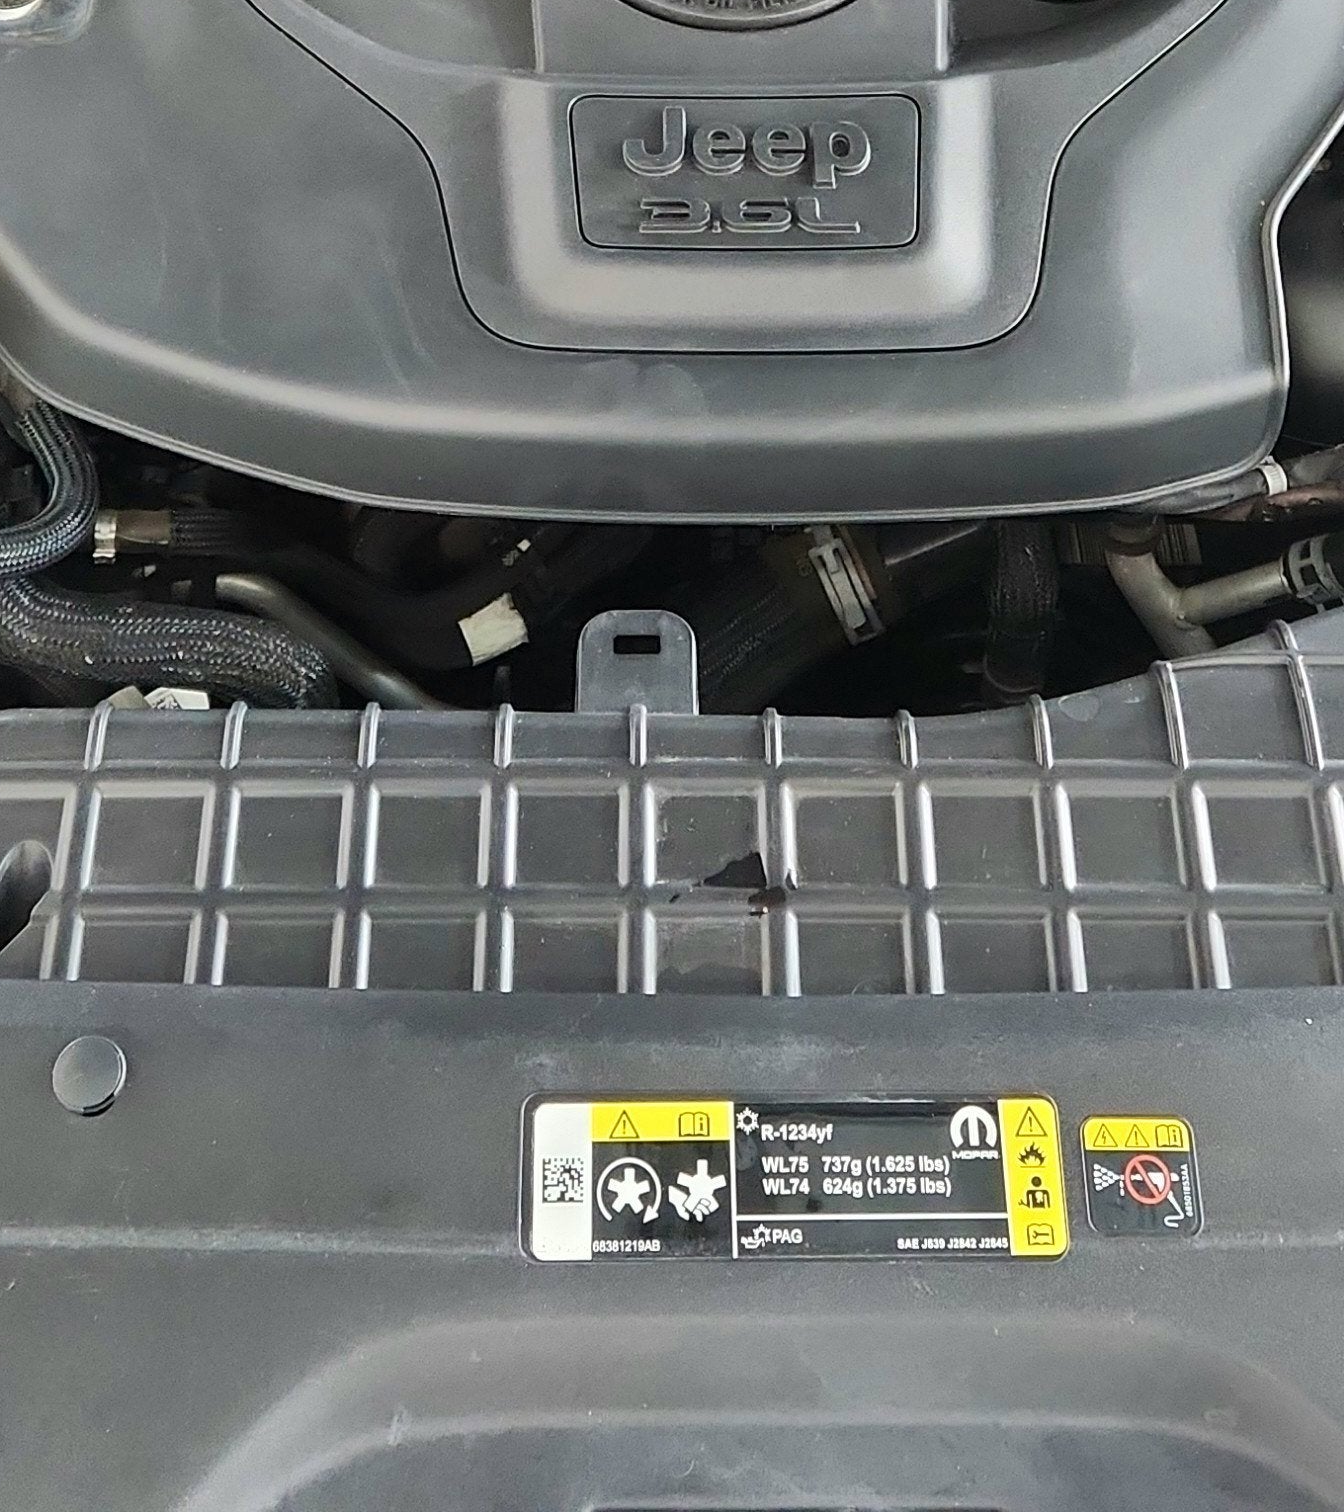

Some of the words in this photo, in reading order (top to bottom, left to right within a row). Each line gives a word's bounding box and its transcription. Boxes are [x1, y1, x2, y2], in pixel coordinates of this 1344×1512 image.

[622, 105, 871, 189] Jeep
[639, 197, 861, 234] 3.6L
[761, 1124, 833, 1143] R-1234yf
[952, 1150, 999, 1160] MOPAR
[761, 1156, 809, 1174] WL75
[821, 1156, 862, 1176] 737g
[866, 1156, 915, 1176] (1.625
[919, 1155, 950, 1176] lbs)
[762, 1178, 810, 1196] WL74
[822, 1178, 863, 1198] 624g
[867, 1177, 916, 1198] (1.375
[920, 1177, 952, 1197] lbs)
[592, 1239, 661, 1252] 68381219AB
[772, 1229, 803, 1244] PAG
[897, 1237, 919, 1249] SAE
